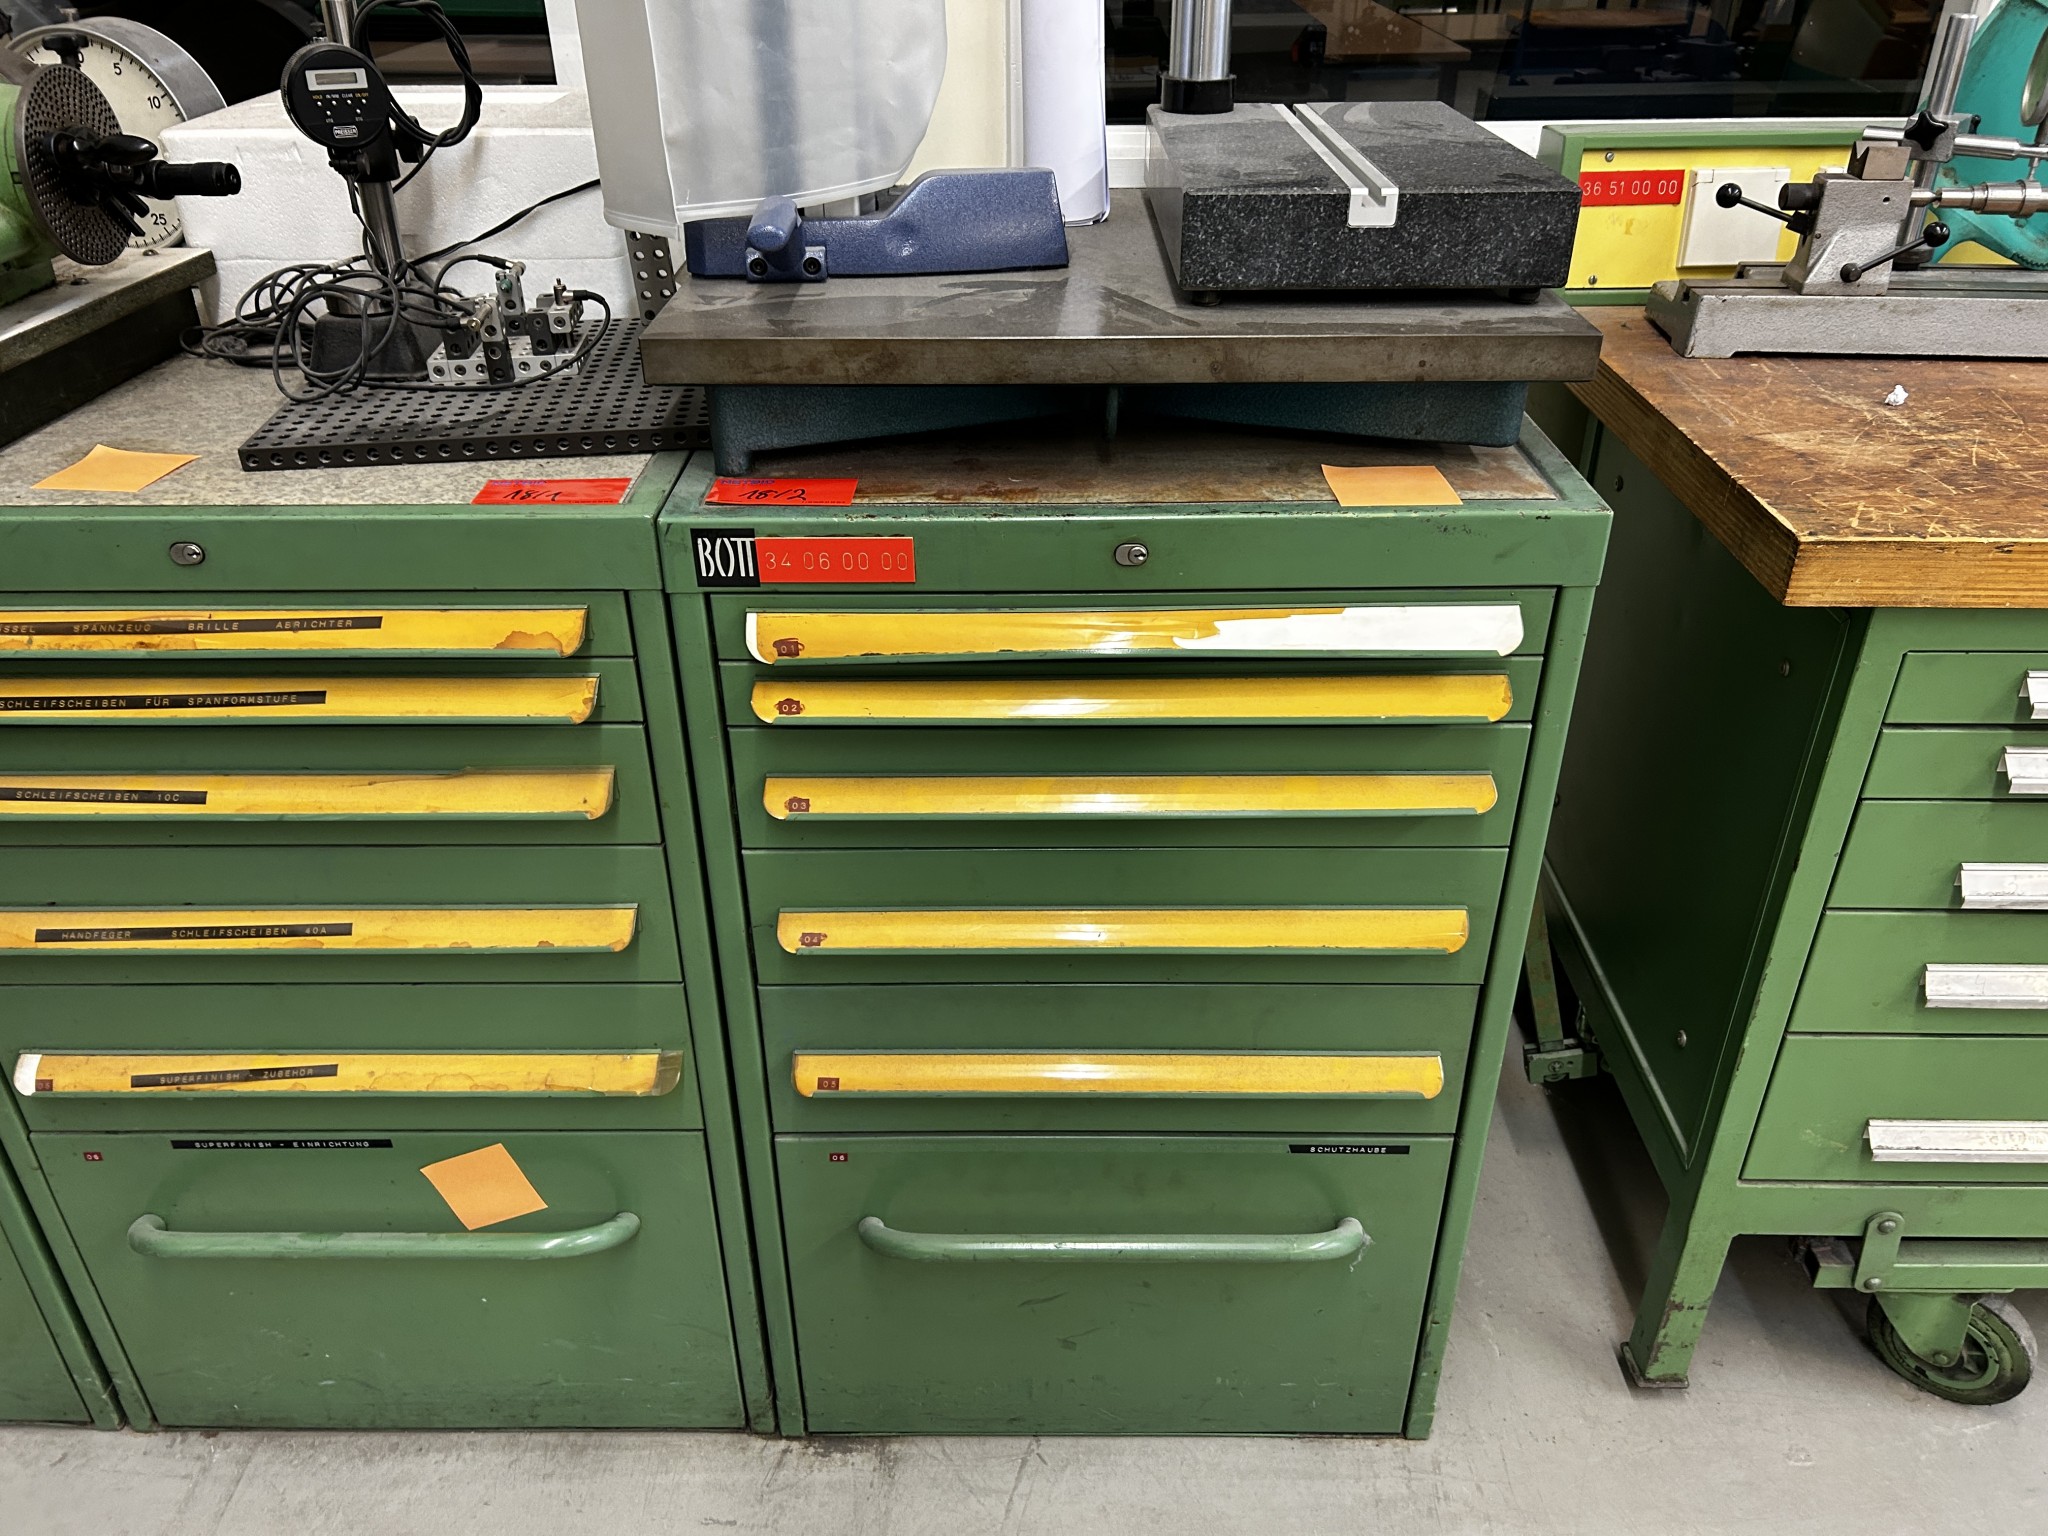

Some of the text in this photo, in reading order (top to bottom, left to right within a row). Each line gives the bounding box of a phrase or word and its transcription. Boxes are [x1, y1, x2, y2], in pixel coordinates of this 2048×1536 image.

[112, 62, 122, 76] 5
[147, 96, 161, 109] 10
[1583, 180, 1678, 196] 36 51 00 00
[150, 213, 167, 226] 25
[697, 537, 756, 577] BOTT
[765, 551, 908, 570] 34 06 00 00
[0, 619, 353, 634] SSEL SPANNZEUG BRILLE ABRICHTER
[780, 645, 796, 653] 01
[0, 694, 298, 709] SCHLEIFSCHEIBEN FÜR SPANFORMSTUFE
[782, 704, 798, 712] 02
[15, 790, 181, 802] SCHLEIFSCHEIBEN 10C
[792, 802, 807, 810] 03
[61, 930, 132, 940] HANDFEGER
[171, 928, 288, 938] SCHLEIFSCHEIBEN
[804, 935, 818, 944] 04
[159, 1072, 240, 1085] SUPERFINISH
[822, 1080, 837, 1088] 05
[194, 1141, 272, 1149] SUPERFINISH
[293, 1140, 370, 1148] EINRICHTUNG
[1309, 1146, 1388, 1154] SCHUTZHAUBE
